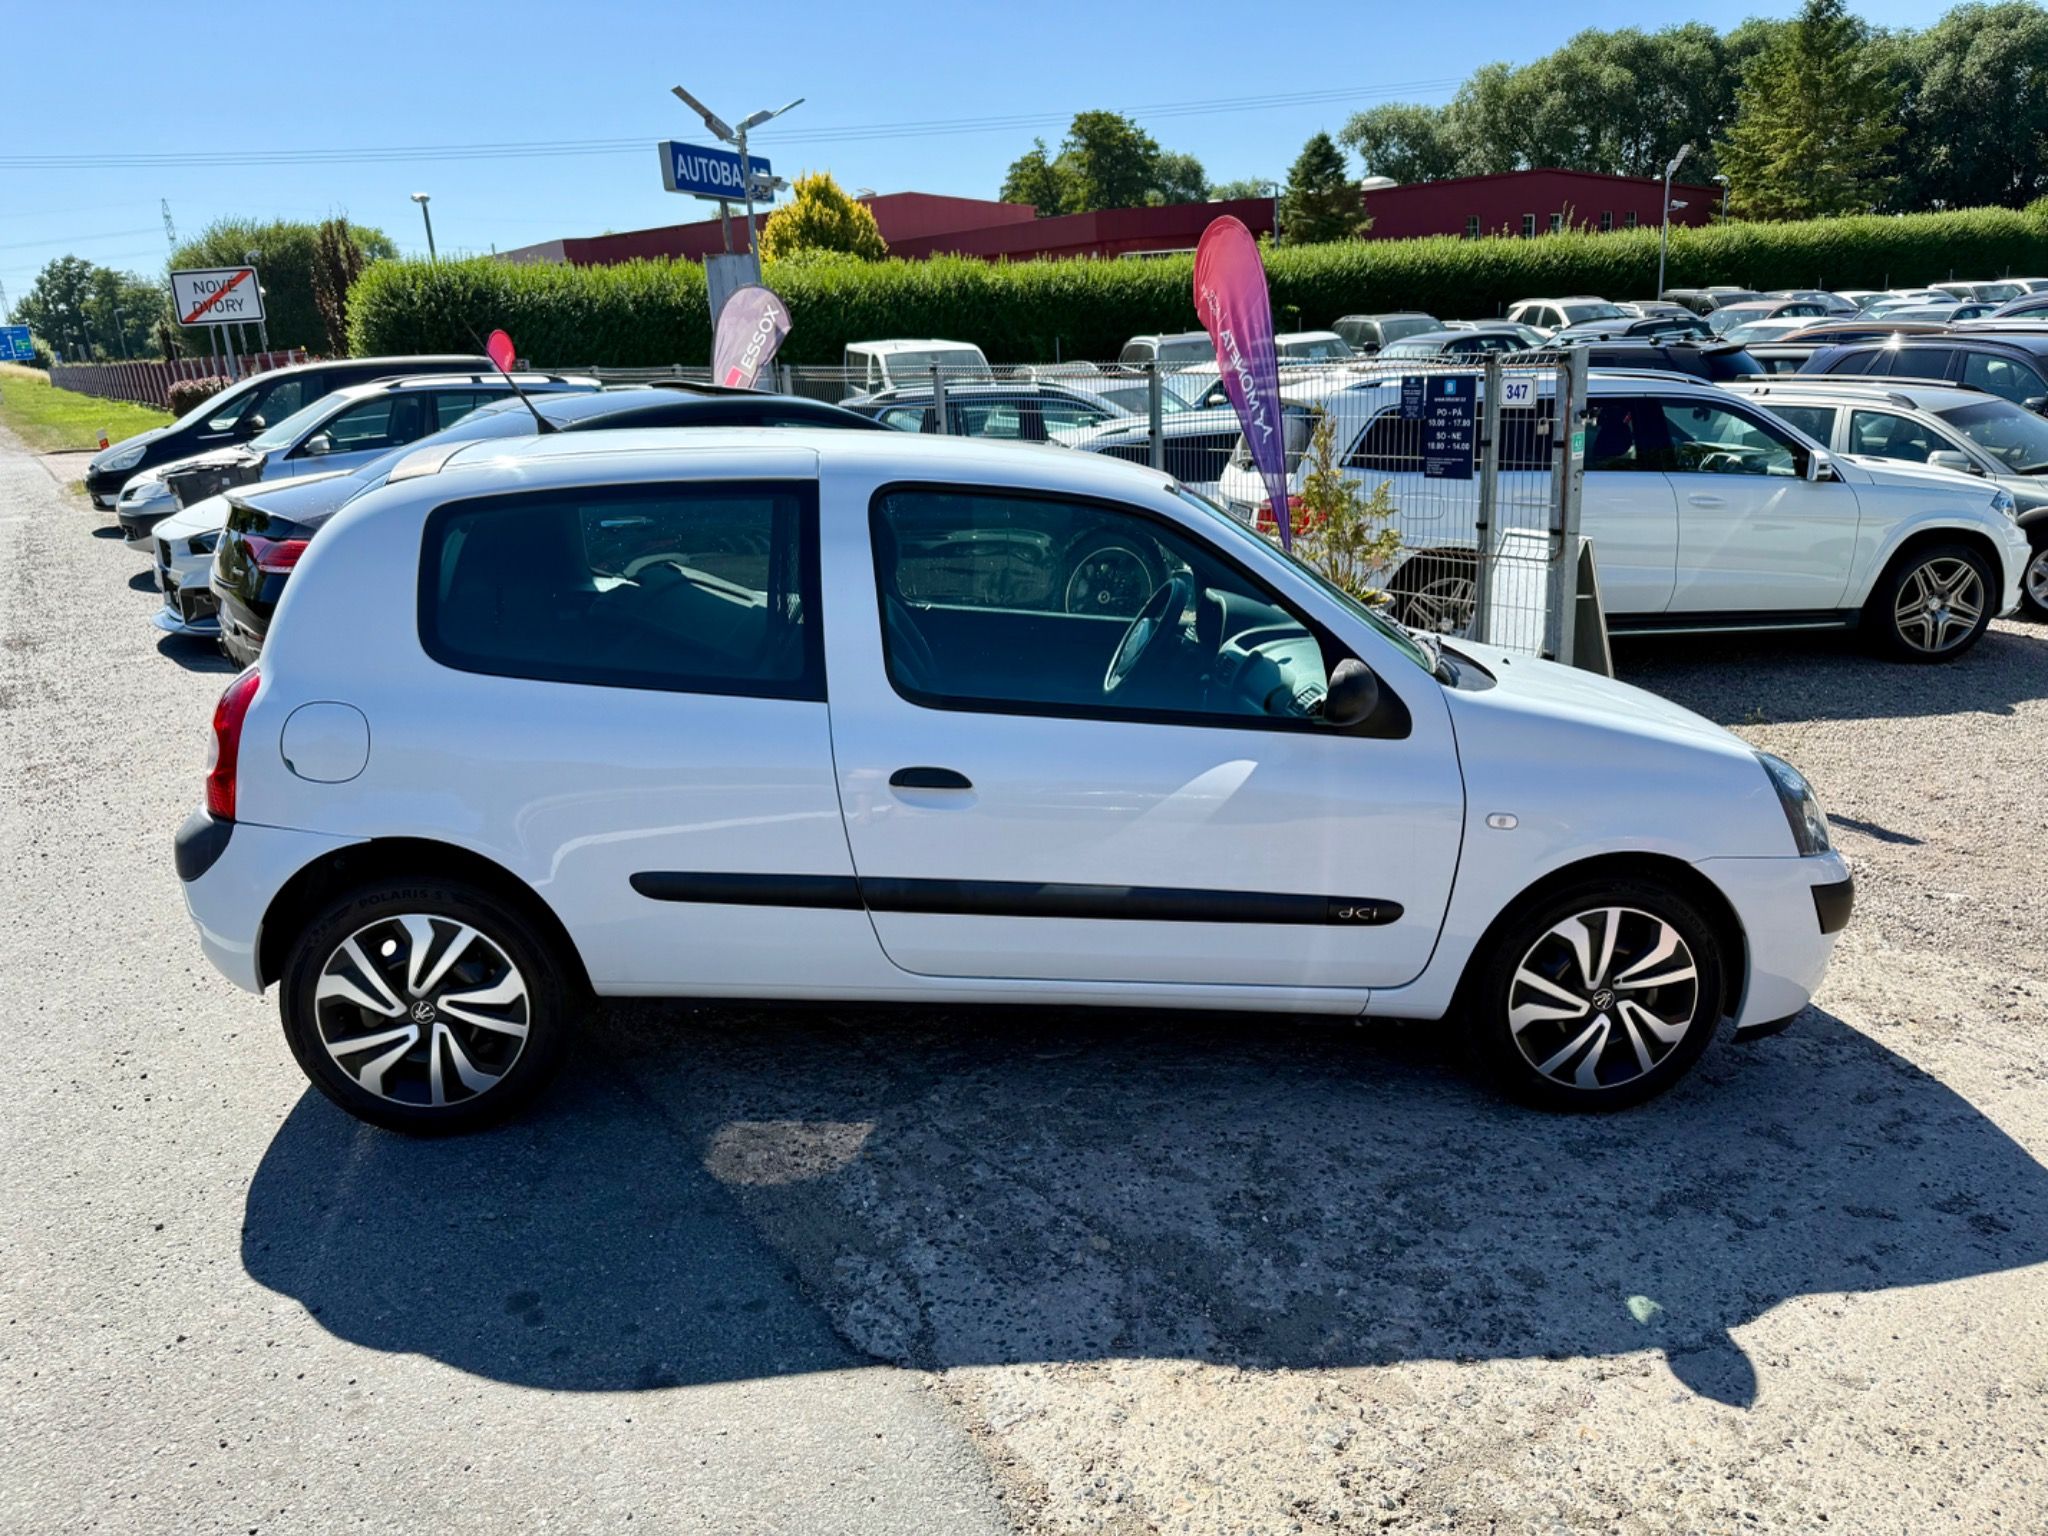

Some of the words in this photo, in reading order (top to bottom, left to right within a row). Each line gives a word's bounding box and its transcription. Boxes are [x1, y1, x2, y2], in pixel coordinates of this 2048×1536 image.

[192, 276, 239, 294] NOVÉ
[192, 298, 244, 314] DVORY
[741, 304, 780, 369] ESSOX
[1506, 384, 1528, 399] 347
[1436, 408, 1447, 416] PO
[1452, 406, 1462, 416] PÁ
[1436, 431, 1446, 440] SO
[1451, 432, 1462, 440] NE
[358, 888, 428, 907] POLARIS
